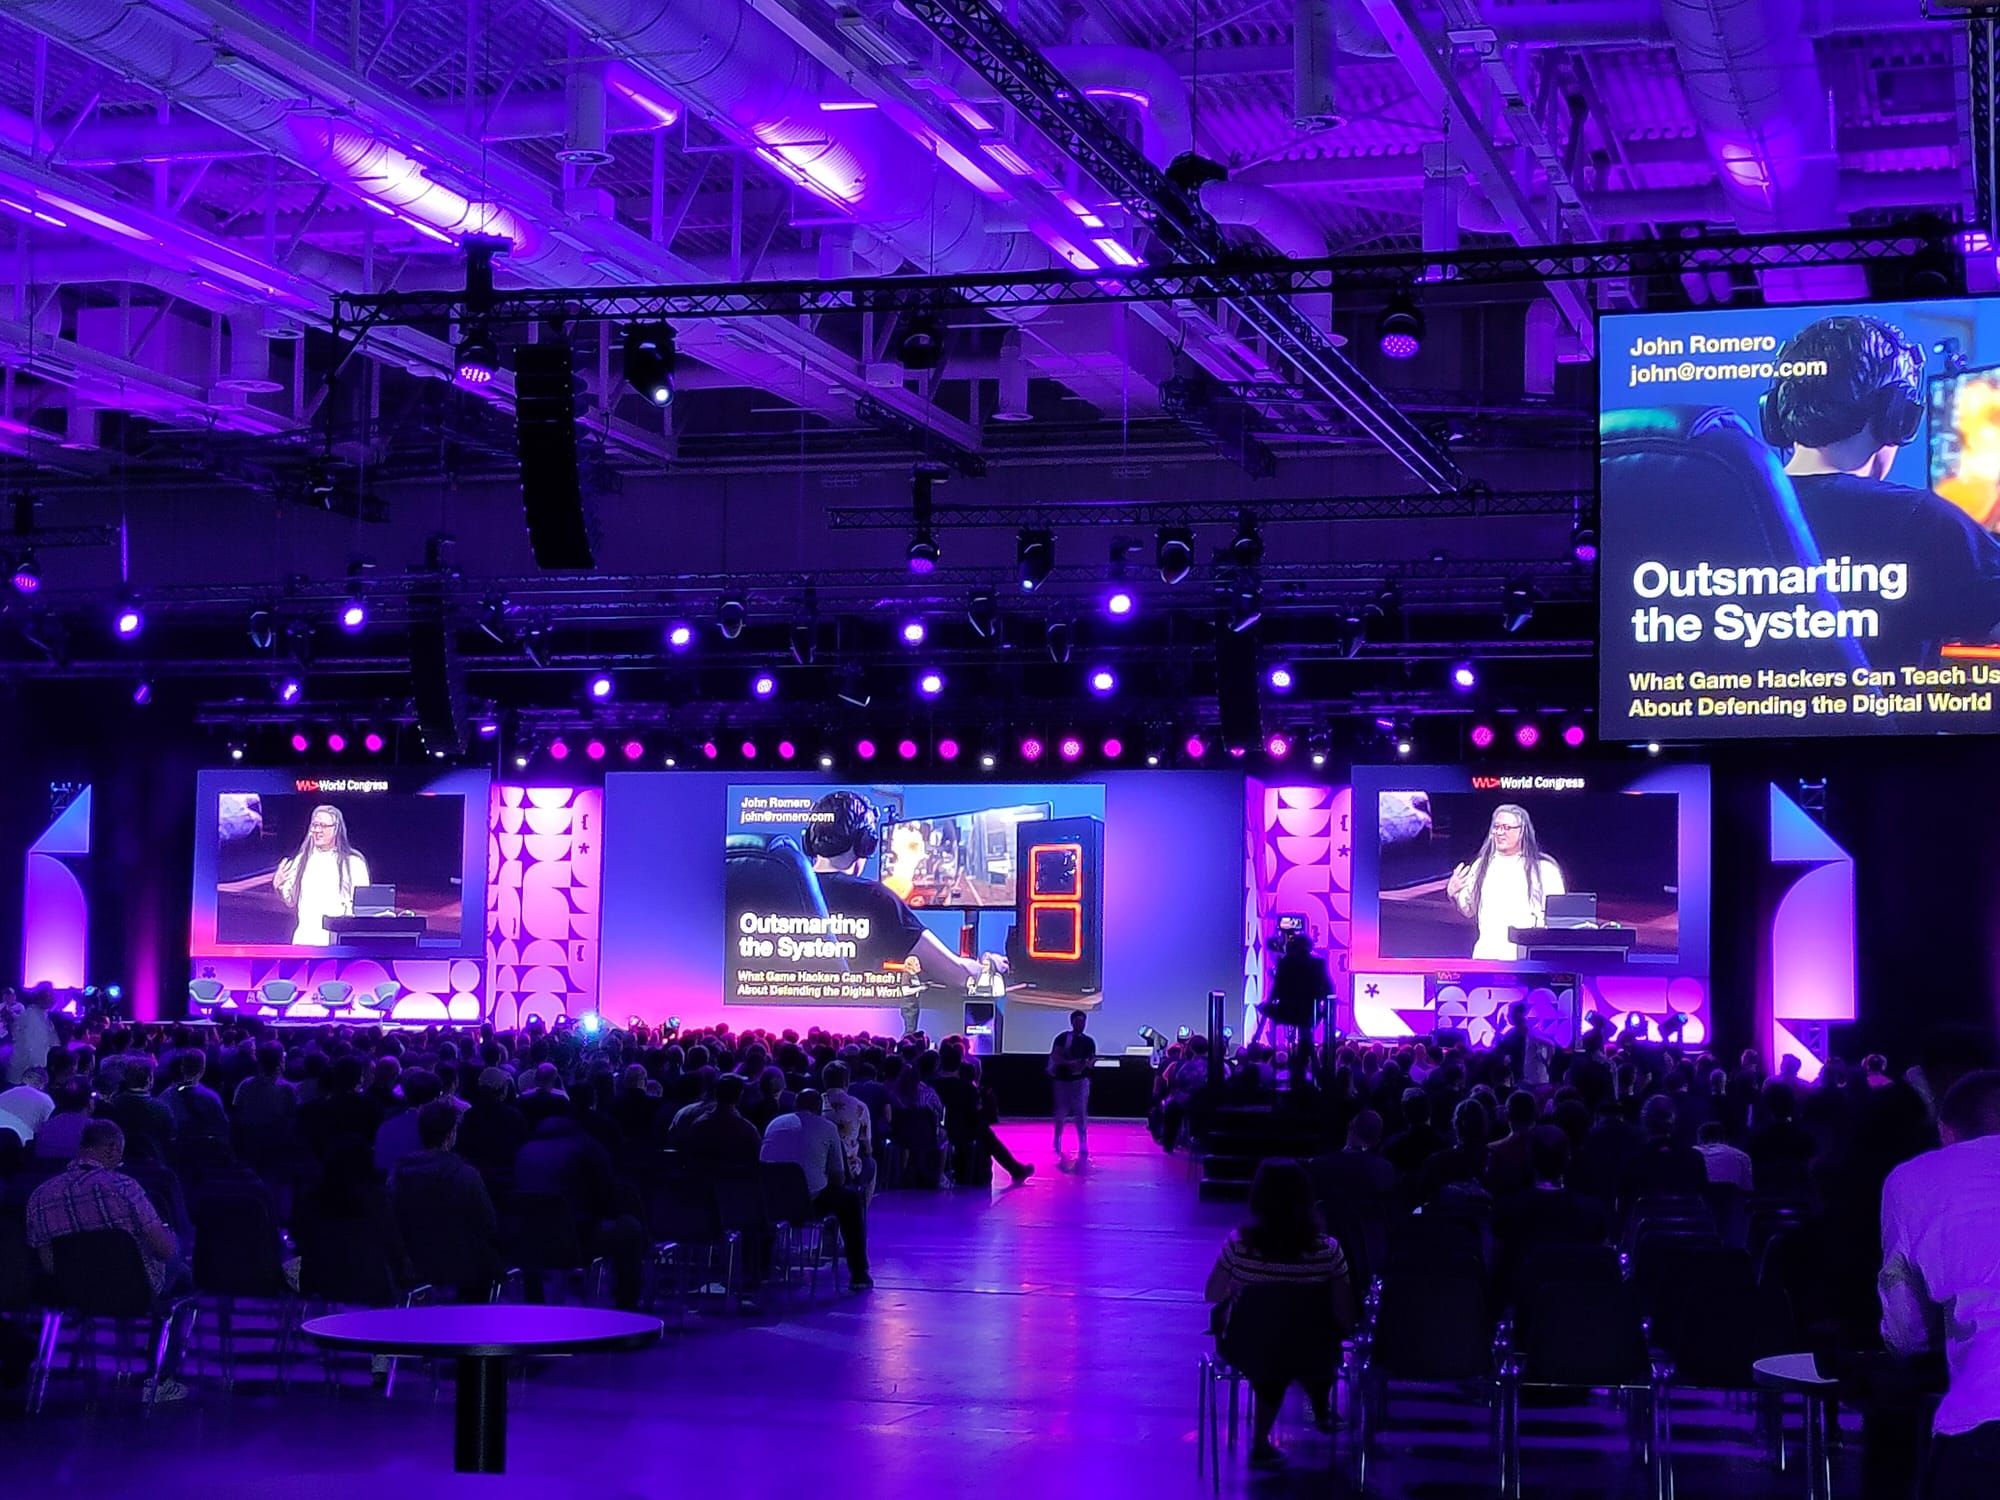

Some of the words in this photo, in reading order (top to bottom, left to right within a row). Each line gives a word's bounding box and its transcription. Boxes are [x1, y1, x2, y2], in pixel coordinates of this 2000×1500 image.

[1630, 336, 1683, 356] John
[1690, 335, 1776, 354] Romero
[1630, 359, 1827, 387] john@romero.com
[1633, 557, 1908, 598] Outsmarting
[1632, 606, 1702, 643] the
[1714, 603, 1879, 647] System
[1629, 673, 1684, 691] What
[1689, 671, 1752, 690] Game
[1757, 668, 1847, 688] Hackers
[1852, 667, 1896, 686] Can
[1901, 665, 1966, 685] Teach
[1628, 697, 1693, 717] About
[1698, 695, 1807, 717] Defending
[1812, 695, 1848, 713] the
[1853, 693, 1922, 714] Digital
[1926, 692, 1992, 712] World
[319, 779, 346, 791] World
[347, 780, 389, 793] Congress
[1500, 776, 1533, 789] World
[1534, 776, 1585, 791] Congress
[741, 797, 767, 808] John
[769, 797, 811, 808] Romero
[740, 811, 835, 824] john@romero.com
[739, 912, 870, 939] Outsmarting
[739, 936, 774, 957] the
[777, 936, 856, 961] System
[737, 971, 764, 982] What
[766, 972, 796, 982] Game
[798, 972, 839, 983] Hackers
[841, 972, 863, 983] Can
[864, 973, 896, 984] Teach
[737, 985, 768, 995] About
[770, 985, 822, 997] Defending
[823, 986, 840, 996] the
[842, 986, 874, 998] Digital
[876, 986, 904, 998] Worl
